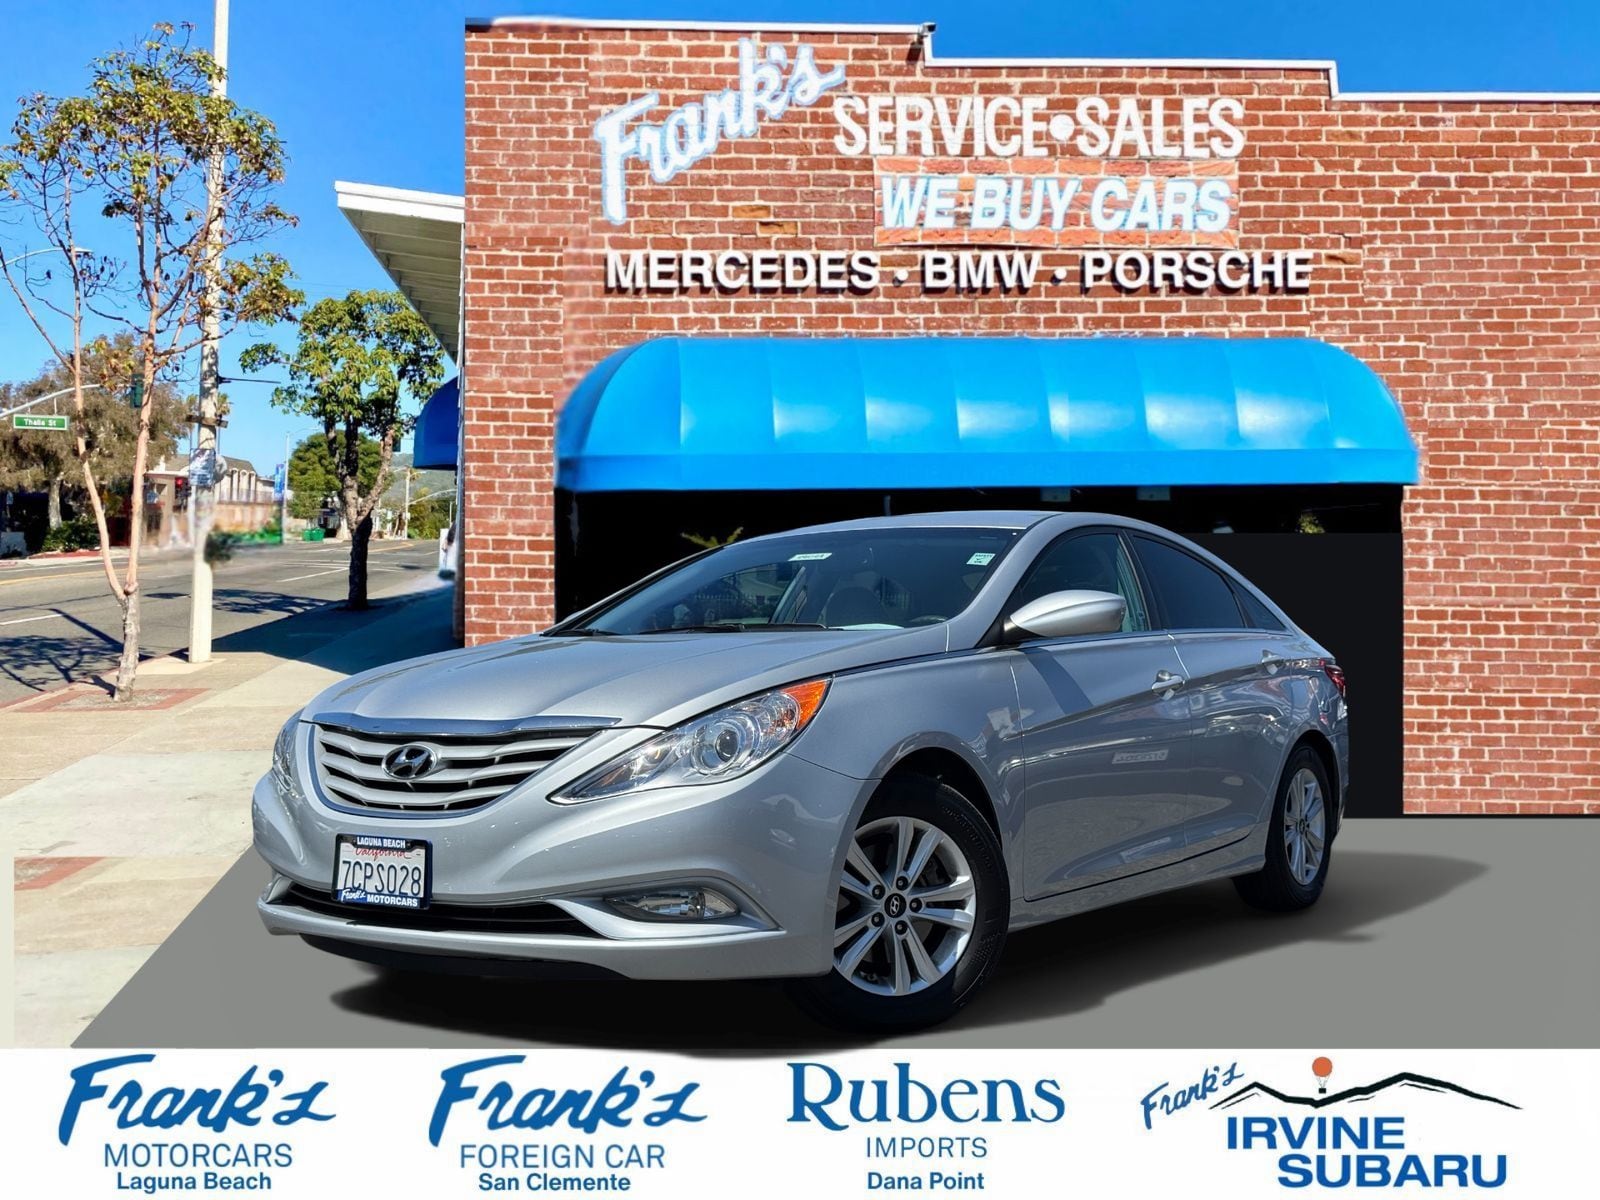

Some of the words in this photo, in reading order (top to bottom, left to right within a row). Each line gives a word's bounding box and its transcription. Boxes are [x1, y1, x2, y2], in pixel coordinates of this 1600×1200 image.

[593, 38, 846, 226] Frank's
[881, 174, 959, 230] WE
[971, 174, 1080, 231] BUY
[1089, 175, 1232, 233] CARS
[605, 251, 881, 292] MERCEDES
[922, 251, 1043, 292] BMW
[1082, 250, 1313, 292] PORSCHE
[48, 419, 57, 427] St
[356, 836, 382, 848] LAGUNA
[383, 838, 406, 849] BEACH
[342, 860, 422, 896] 7CPS028
[366, 893, 419, 908] MOTORCARS
